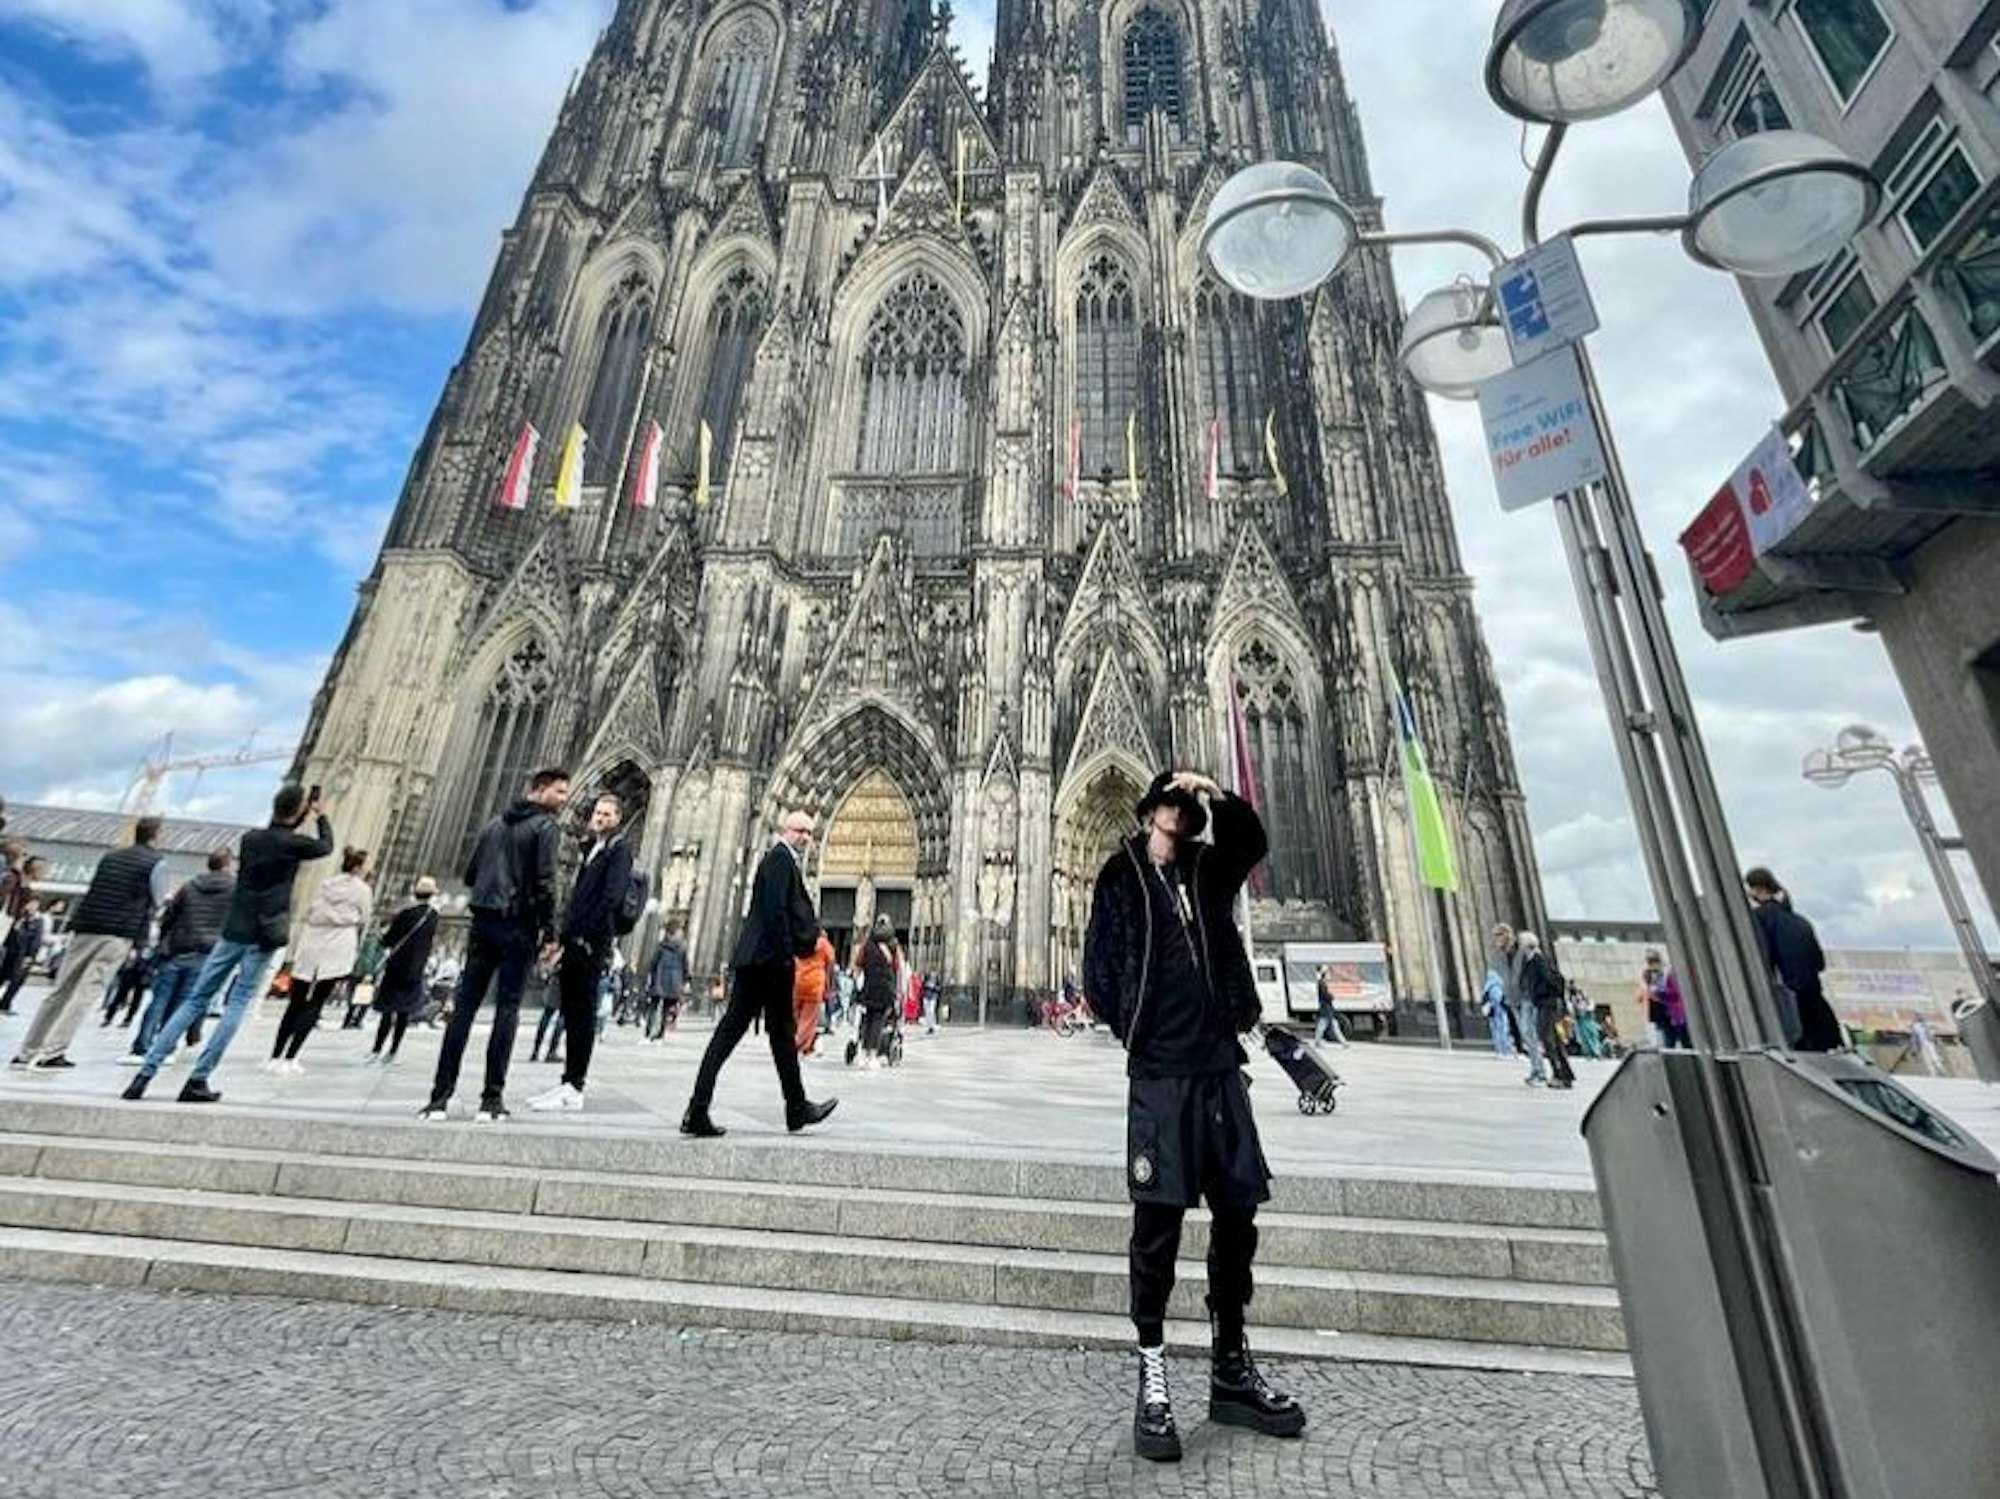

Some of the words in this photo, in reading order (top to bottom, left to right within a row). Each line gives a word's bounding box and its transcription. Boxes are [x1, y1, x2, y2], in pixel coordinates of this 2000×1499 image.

[1492, 423, 1533, 449] Free
[1496, 448, 1523, 472] für
[1528, 427, 1571, 458] alle!
